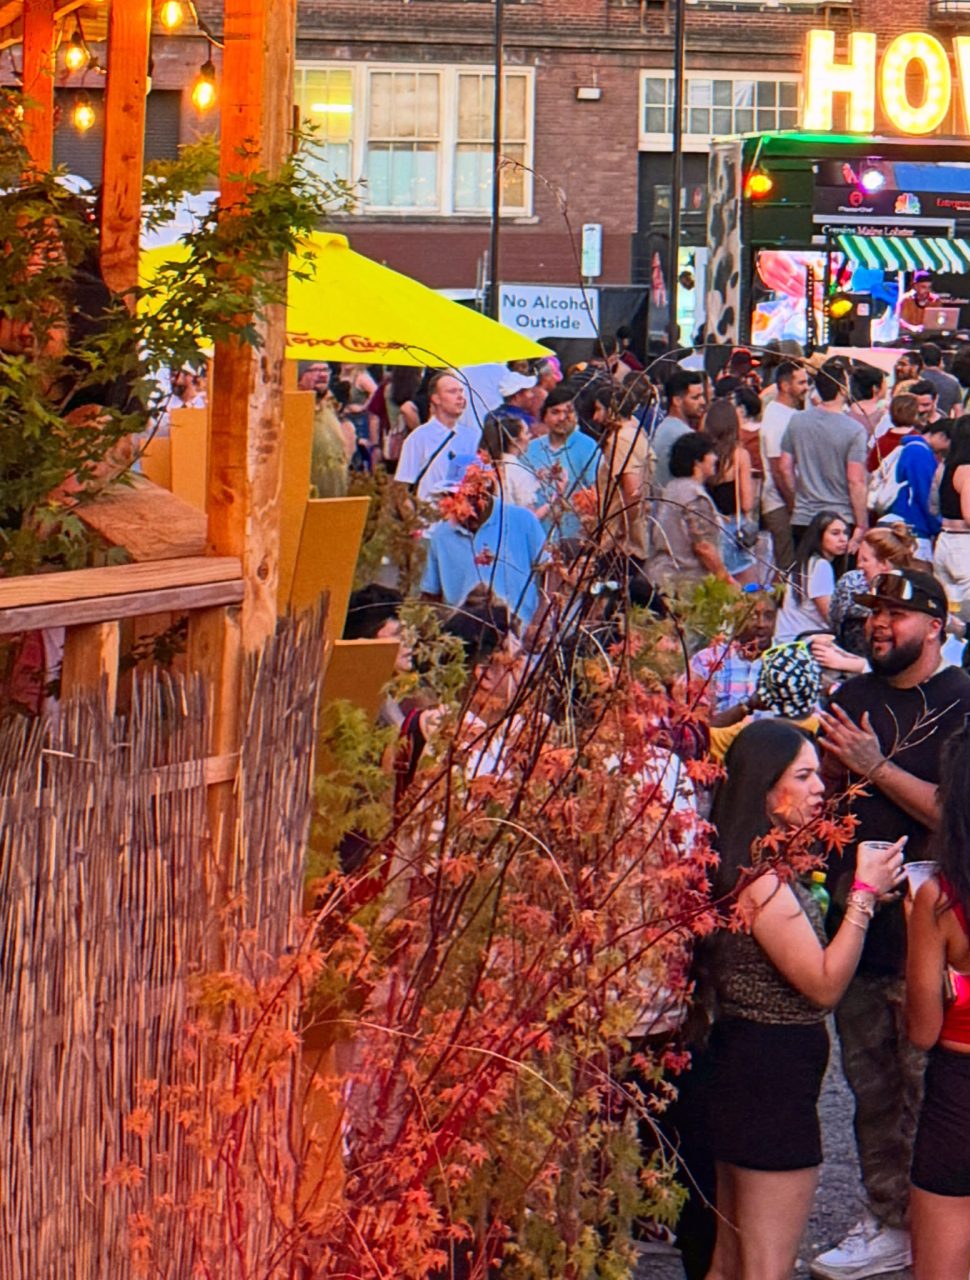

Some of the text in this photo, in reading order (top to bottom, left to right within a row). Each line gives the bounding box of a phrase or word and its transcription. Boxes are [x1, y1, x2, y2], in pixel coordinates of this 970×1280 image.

[503, 294, 594, 311] No Alcohol
[515, 315, 581, 330] Outside
